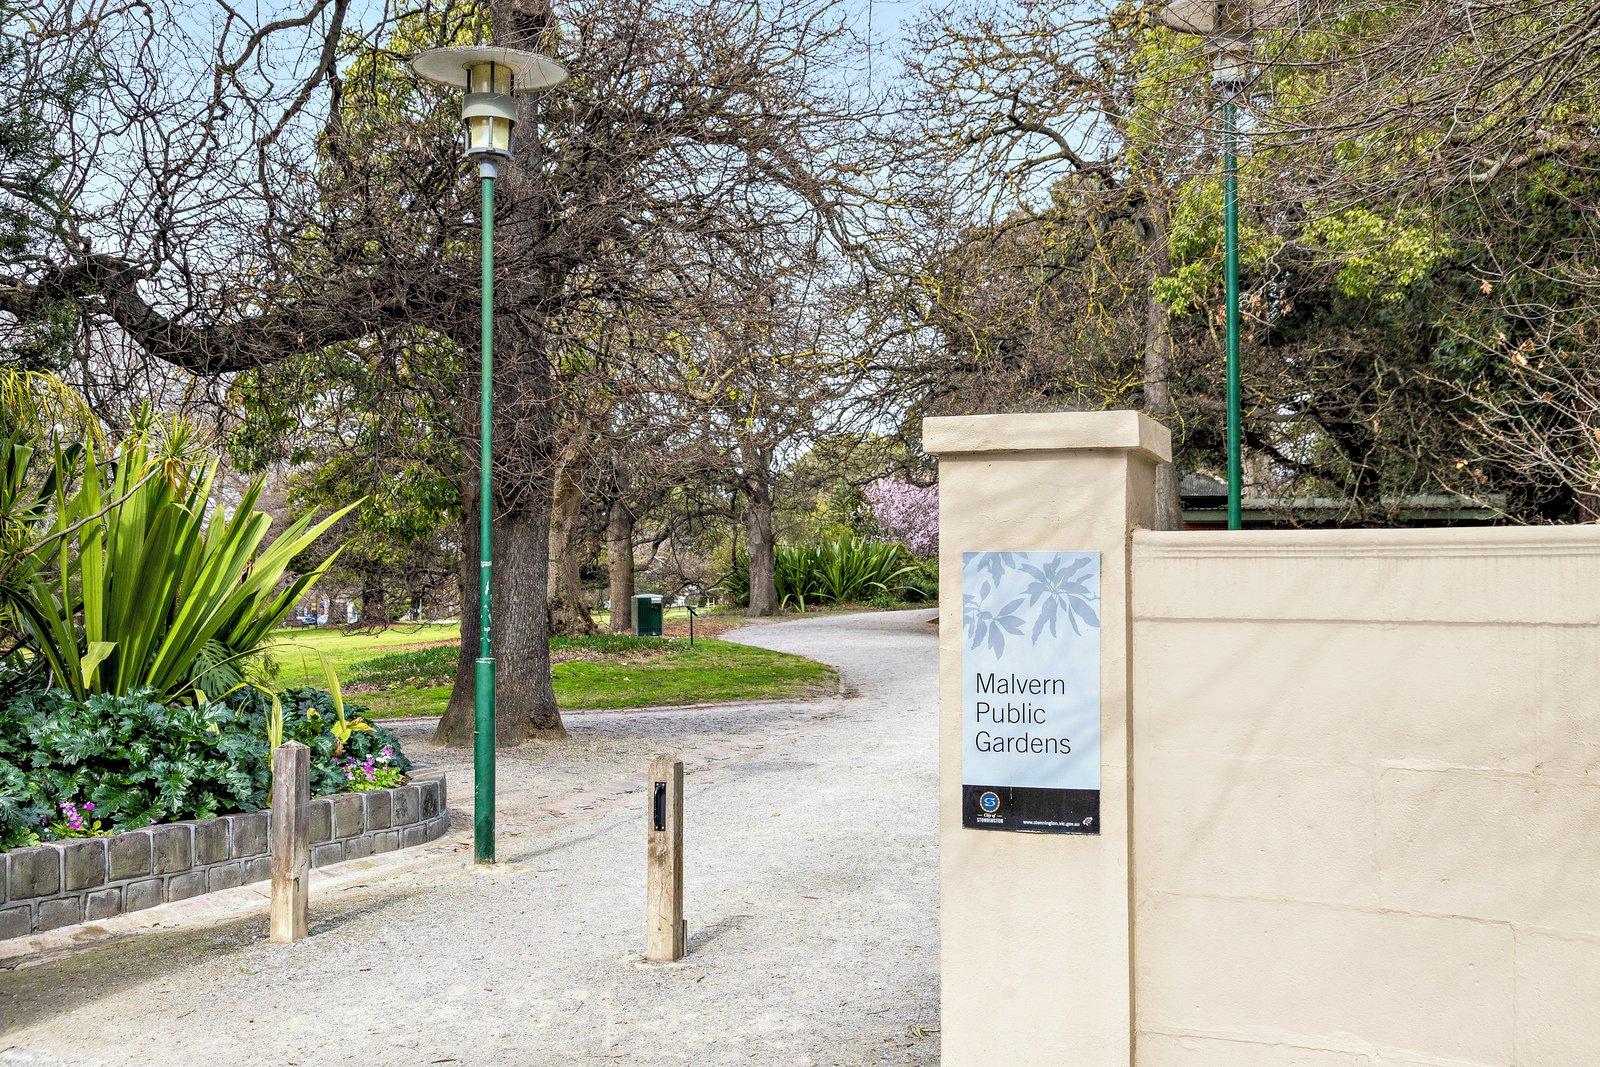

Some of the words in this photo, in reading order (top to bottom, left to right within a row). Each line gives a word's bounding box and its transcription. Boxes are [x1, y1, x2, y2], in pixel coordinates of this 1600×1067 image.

[976, 673, 1064, 694] Malvern
[976, 702, 1046, 724] Public
[976, 730, 1070, 754] Gardens
